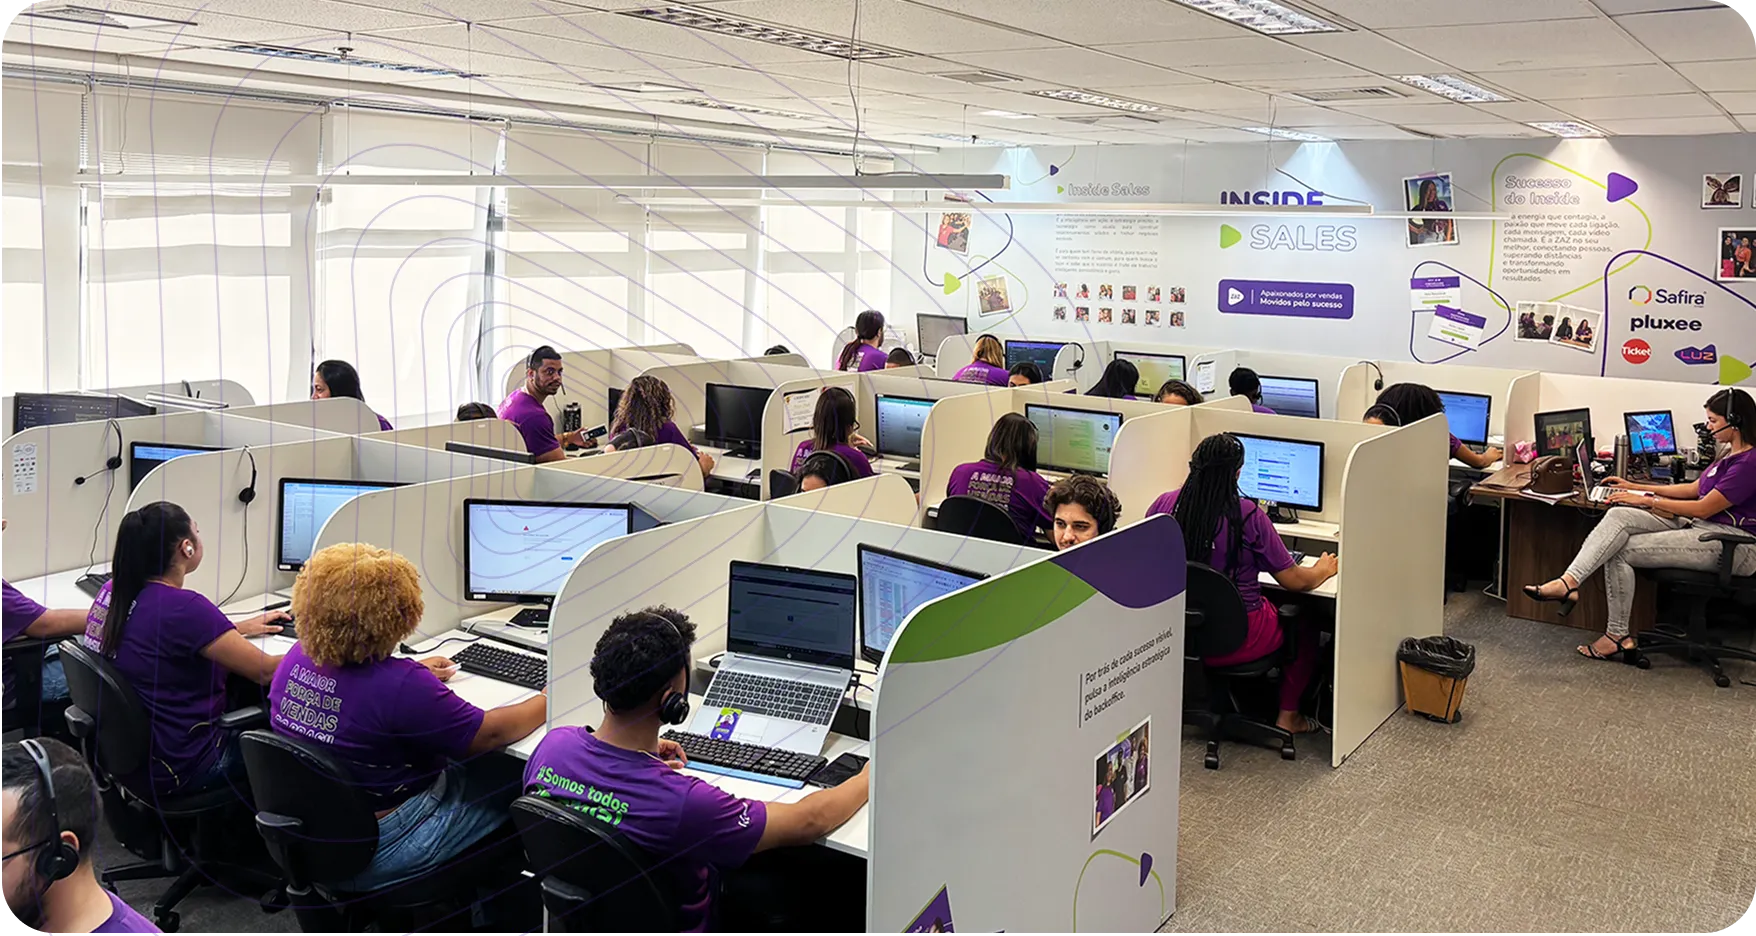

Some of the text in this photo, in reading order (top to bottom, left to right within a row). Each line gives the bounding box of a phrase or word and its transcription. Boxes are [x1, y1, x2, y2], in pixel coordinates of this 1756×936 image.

[1068, 182, 1150, 196] Inside Sales
[1504, 175, 1572, 189] Sucesso
[1504, 191, 1580, 205] do Inside
[1504, 221, 1528, 230] paixão
[1250, 224, 1357, 252] SALES
[1260, 290, 1342, 300] Apaixonados por vendas
[1260, 298, 1292, 306] Movidos
[1293, 299, 1310, 308] pelo
[1655, 288, 1705, 305] Safira
[1630, 314, 1702, 332] pluxee
[1622, 346, 1651, 356] Ticket
[1680, 351, 1714, 360] LUZ
[1085, 671, 1096, 684] Por
[1097, 662, 1110, 677] trás
[1111, 658, 1118, 670] de
[1120, 650, 1133, 665] cada
[1134, 639, 1155, 657] sucesso
[290, 663, 337, 693] A MAIOR
[1085, 646, 1170, 705] pulsa a inteligência estratégica
[285, 679, 342, 713] FORÇA DE
[1084, 691, 1125, 721] do backoffice.
[280, 697, 338, 733] VENDAS
[536, 765, 585, 795] #Somos
[587, 786, 629, 813] todos
